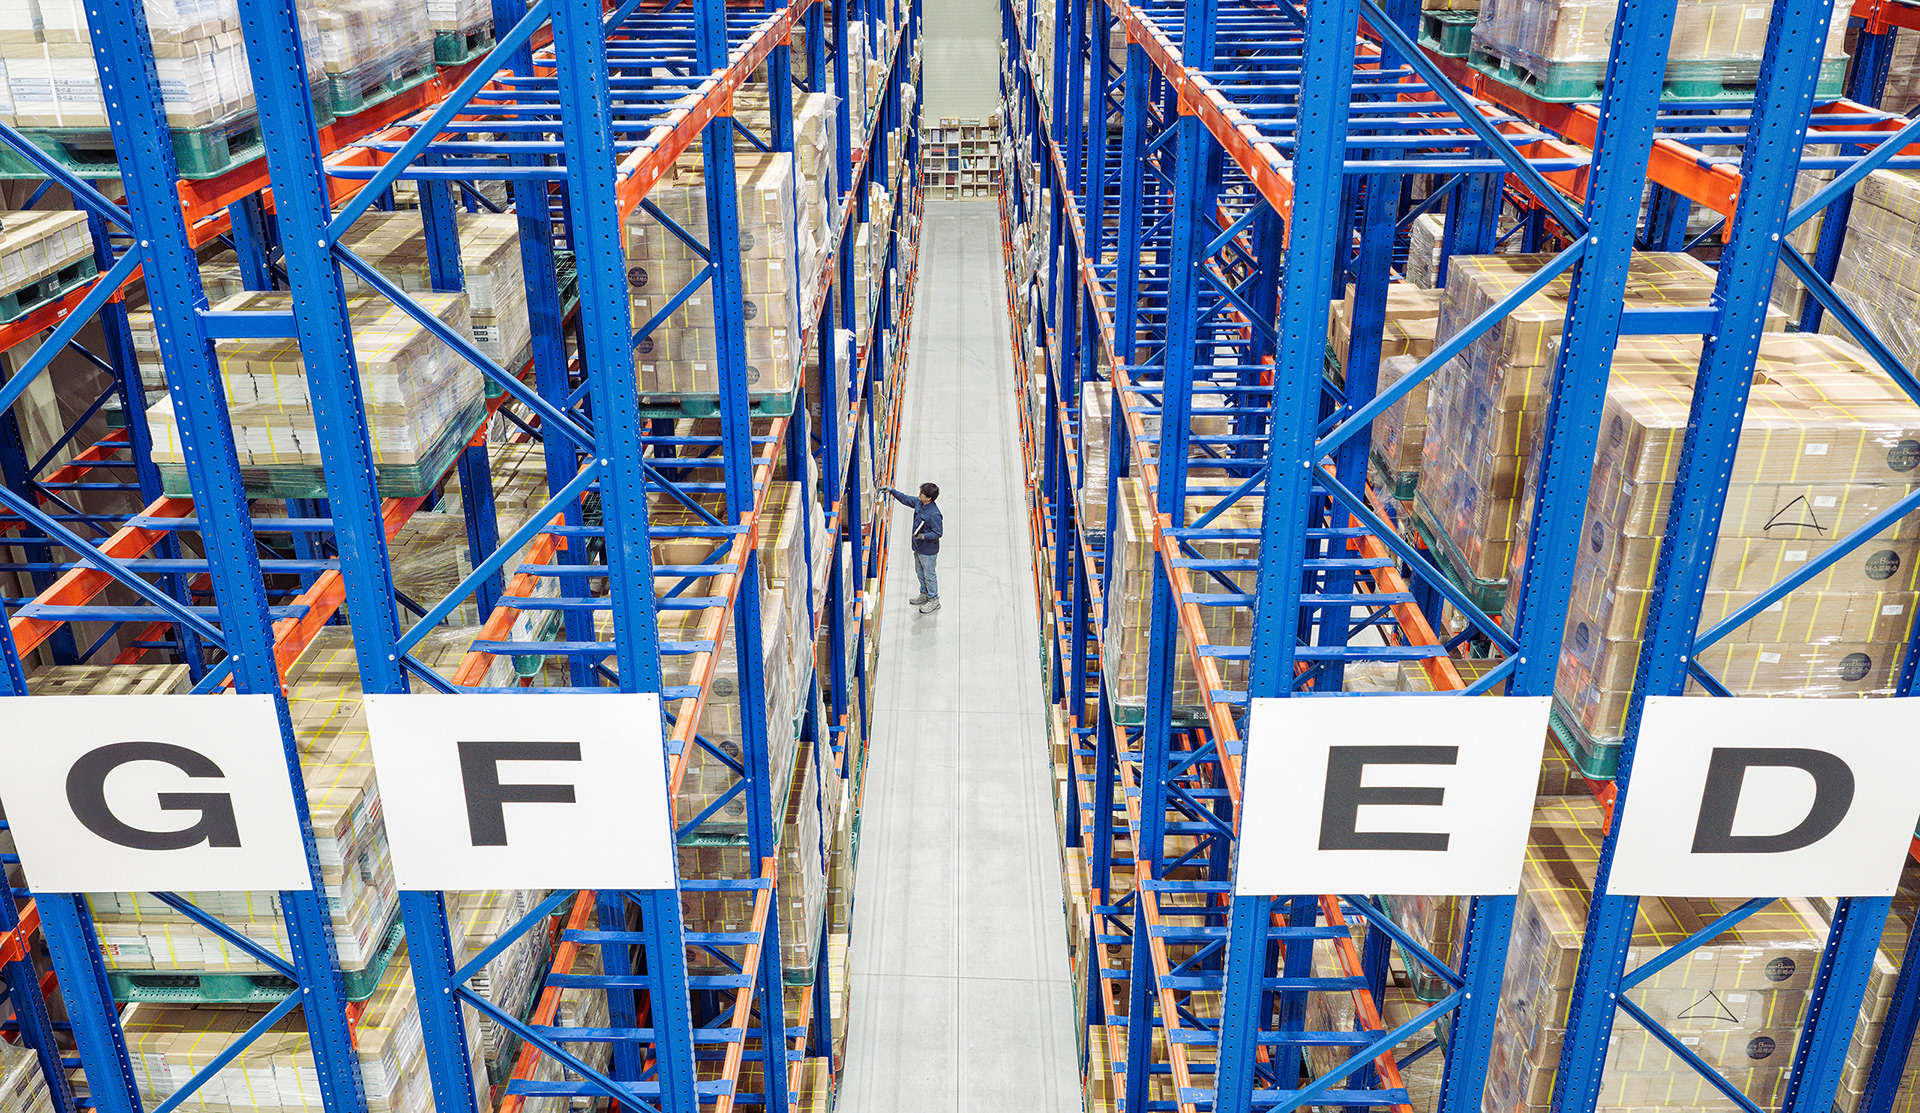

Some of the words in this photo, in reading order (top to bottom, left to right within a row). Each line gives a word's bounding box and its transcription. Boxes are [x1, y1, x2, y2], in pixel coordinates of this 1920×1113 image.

[66, 742, 241, 850] G
[457, 742, 581, 846] F
[1318, 746, 1458, 851] E
[1691, 748, 1854, 853] D
